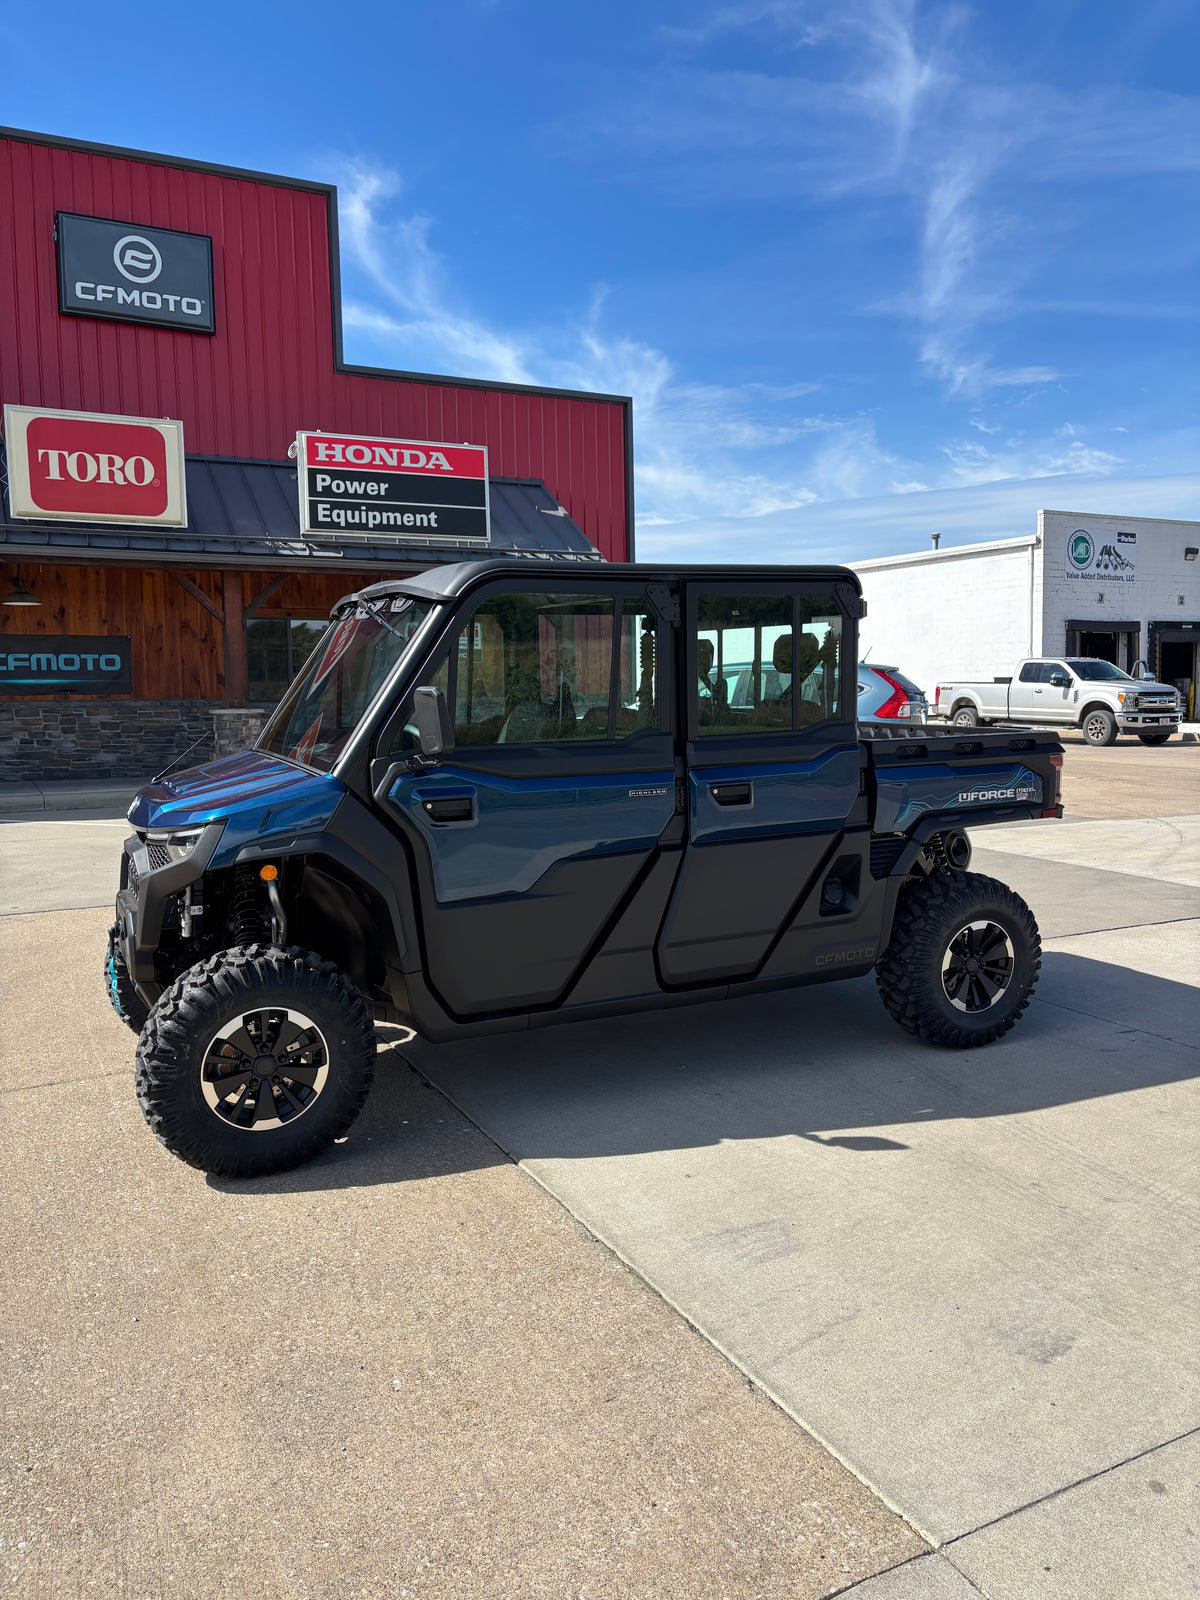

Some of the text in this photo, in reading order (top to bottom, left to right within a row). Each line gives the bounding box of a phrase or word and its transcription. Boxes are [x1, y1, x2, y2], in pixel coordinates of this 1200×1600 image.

[75, 281, 202, 316] CFMOTO
[38, 449, 155, 486] TORO
[314, 442, 454, 471] HONDA
[315, 474, 389, 496] Power
[317, 503, 438, 528] Equipment
[1066, 571, 1079, 580] Value
[1081, 572, 1096, 580] Added
[1126, 574, 1135, 582] LLC
[815, 947, 875, 966] CFMOTO
